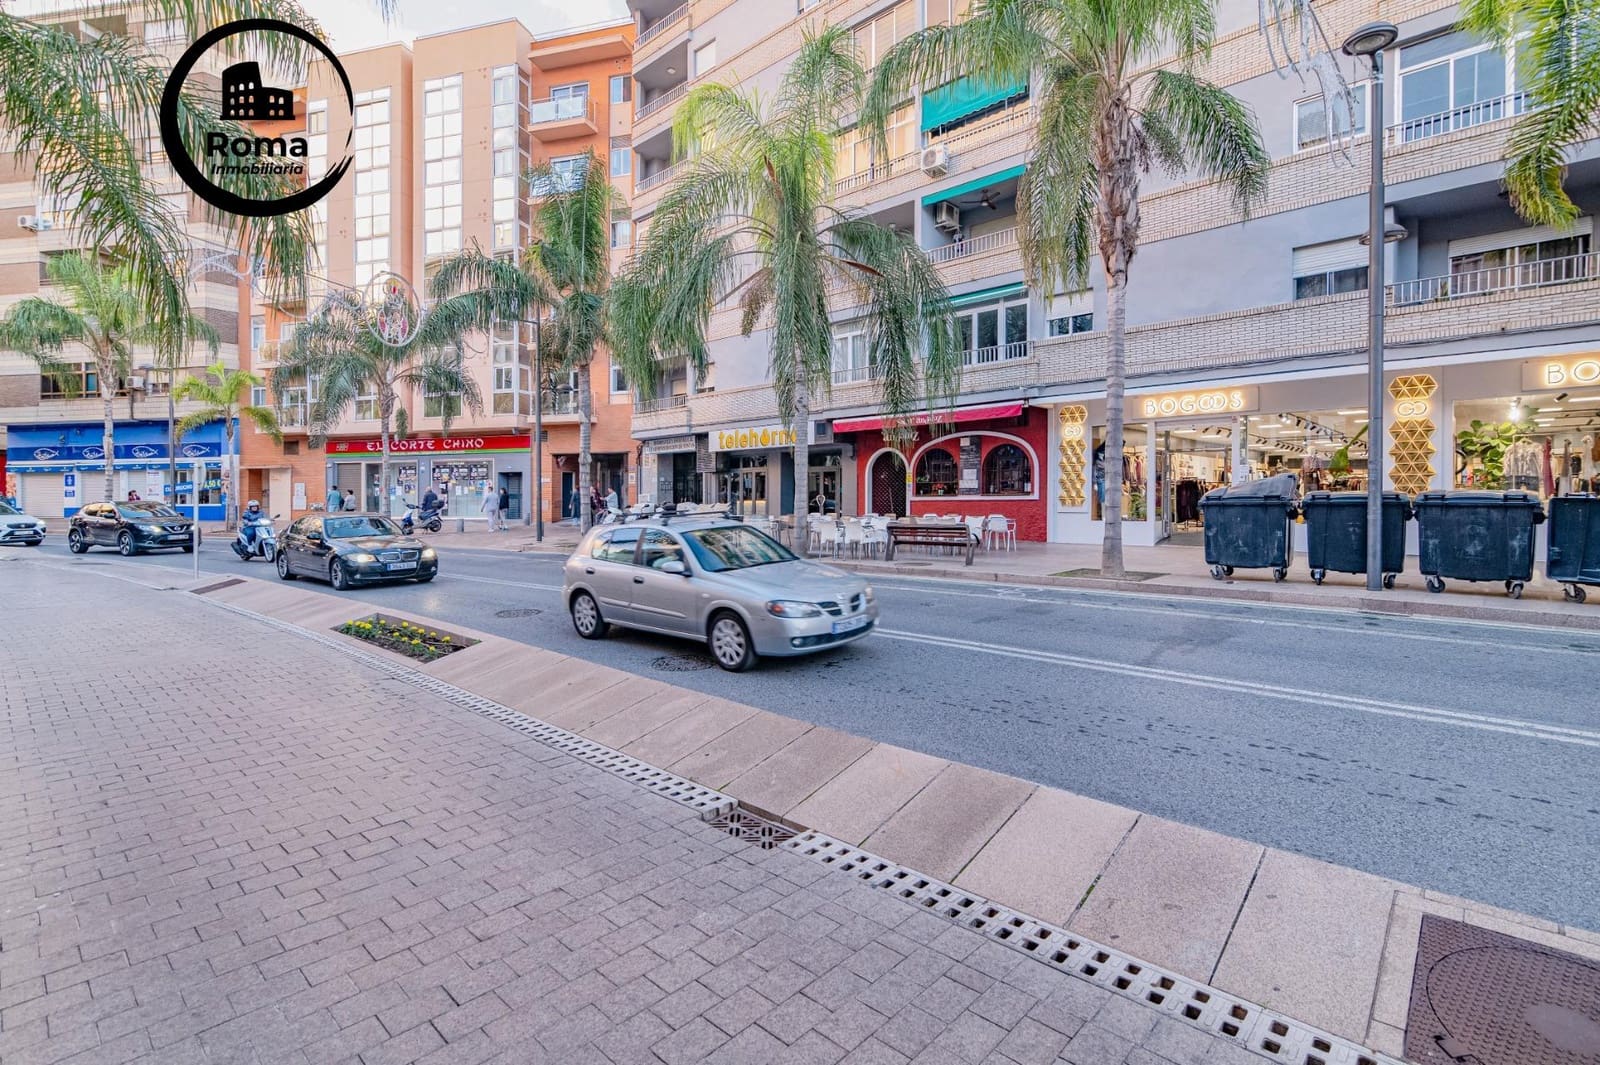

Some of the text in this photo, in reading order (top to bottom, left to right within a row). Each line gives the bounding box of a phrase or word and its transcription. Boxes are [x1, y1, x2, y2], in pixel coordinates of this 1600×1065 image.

[366, 437, 485, 451] EL CORTE CHINO
